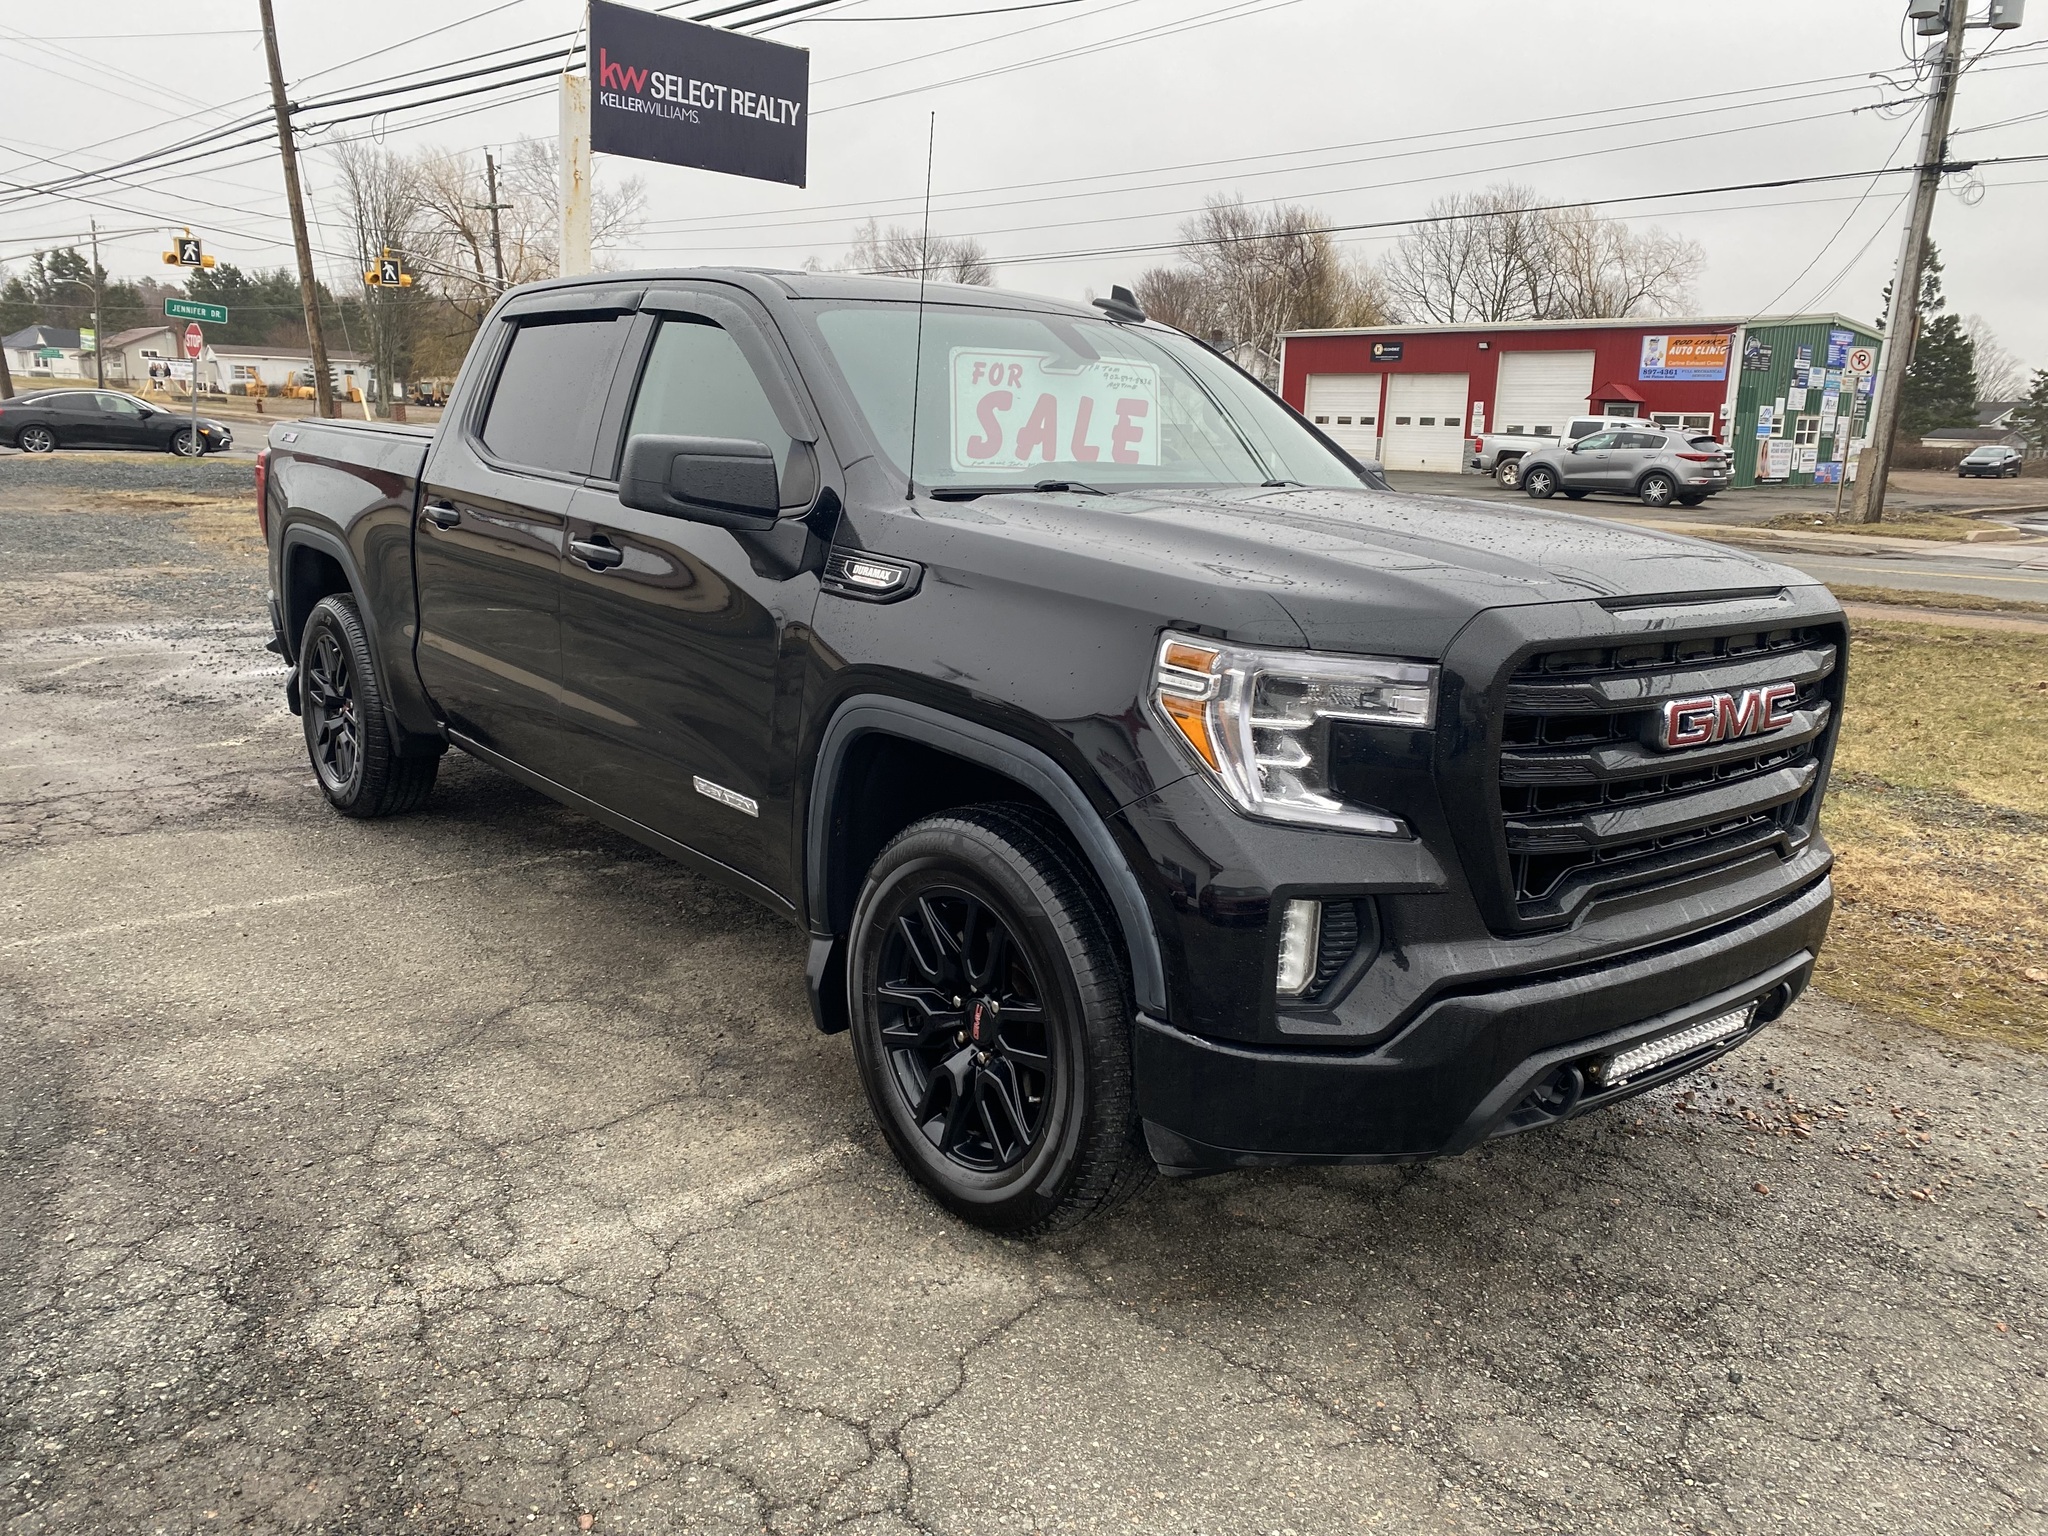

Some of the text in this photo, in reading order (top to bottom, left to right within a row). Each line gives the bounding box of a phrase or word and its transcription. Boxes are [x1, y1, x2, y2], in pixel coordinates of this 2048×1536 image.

[600, 47, 801, 126] kw SELECT REALTY
[172, 304, 221, 318] JENNIFER DR.
[186, 334, 201, 348] STOP
[1669, 345, 1727, 355] AUTO CLINIC
[972, 362, 1023, 388] FOR
[966, 390, 1149, 465] SALE
[852, 565, 891, 580] DURAMAX
[1663, 682, 1796, 748] GMC
[973, 1003, 983, 1040] GMC
